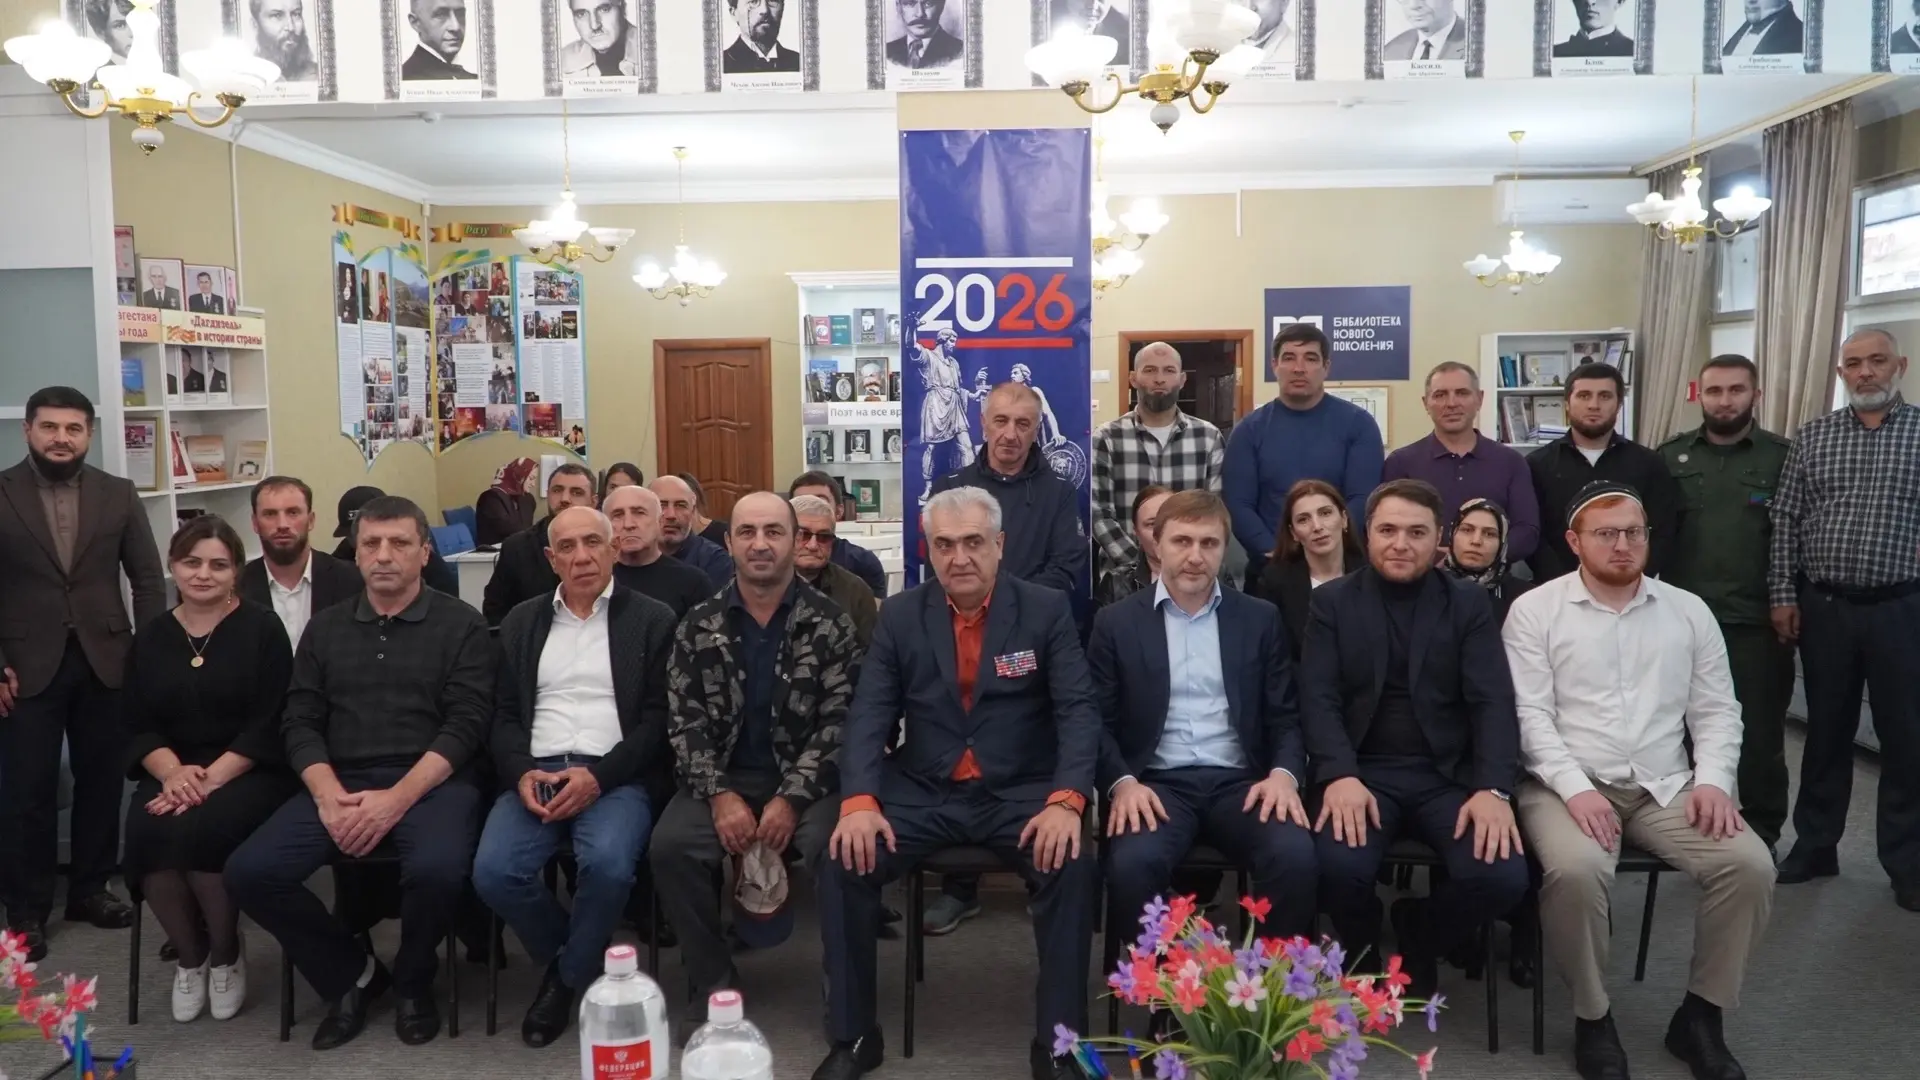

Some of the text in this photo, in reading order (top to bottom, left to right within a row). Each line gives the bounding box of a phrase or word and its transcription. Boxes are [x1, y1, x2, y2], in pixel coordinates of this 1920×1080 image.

[1410, 62, 1443, 70] Кассиль
[915, 273, 1075, 332] 2026
[1333, 316, 1401, 327] БИБЛИОТЕКА
[127, 328, 148, 339] года
[1333, 328, 1375, 339] НОВОГО
[203, 332, 235, 345] истории
[236, 335, 262, 347] страны
[1333, 340, 1394, 351] ПОКОЛЕНИЯ
[830, 408, 853, 417] Поэт
